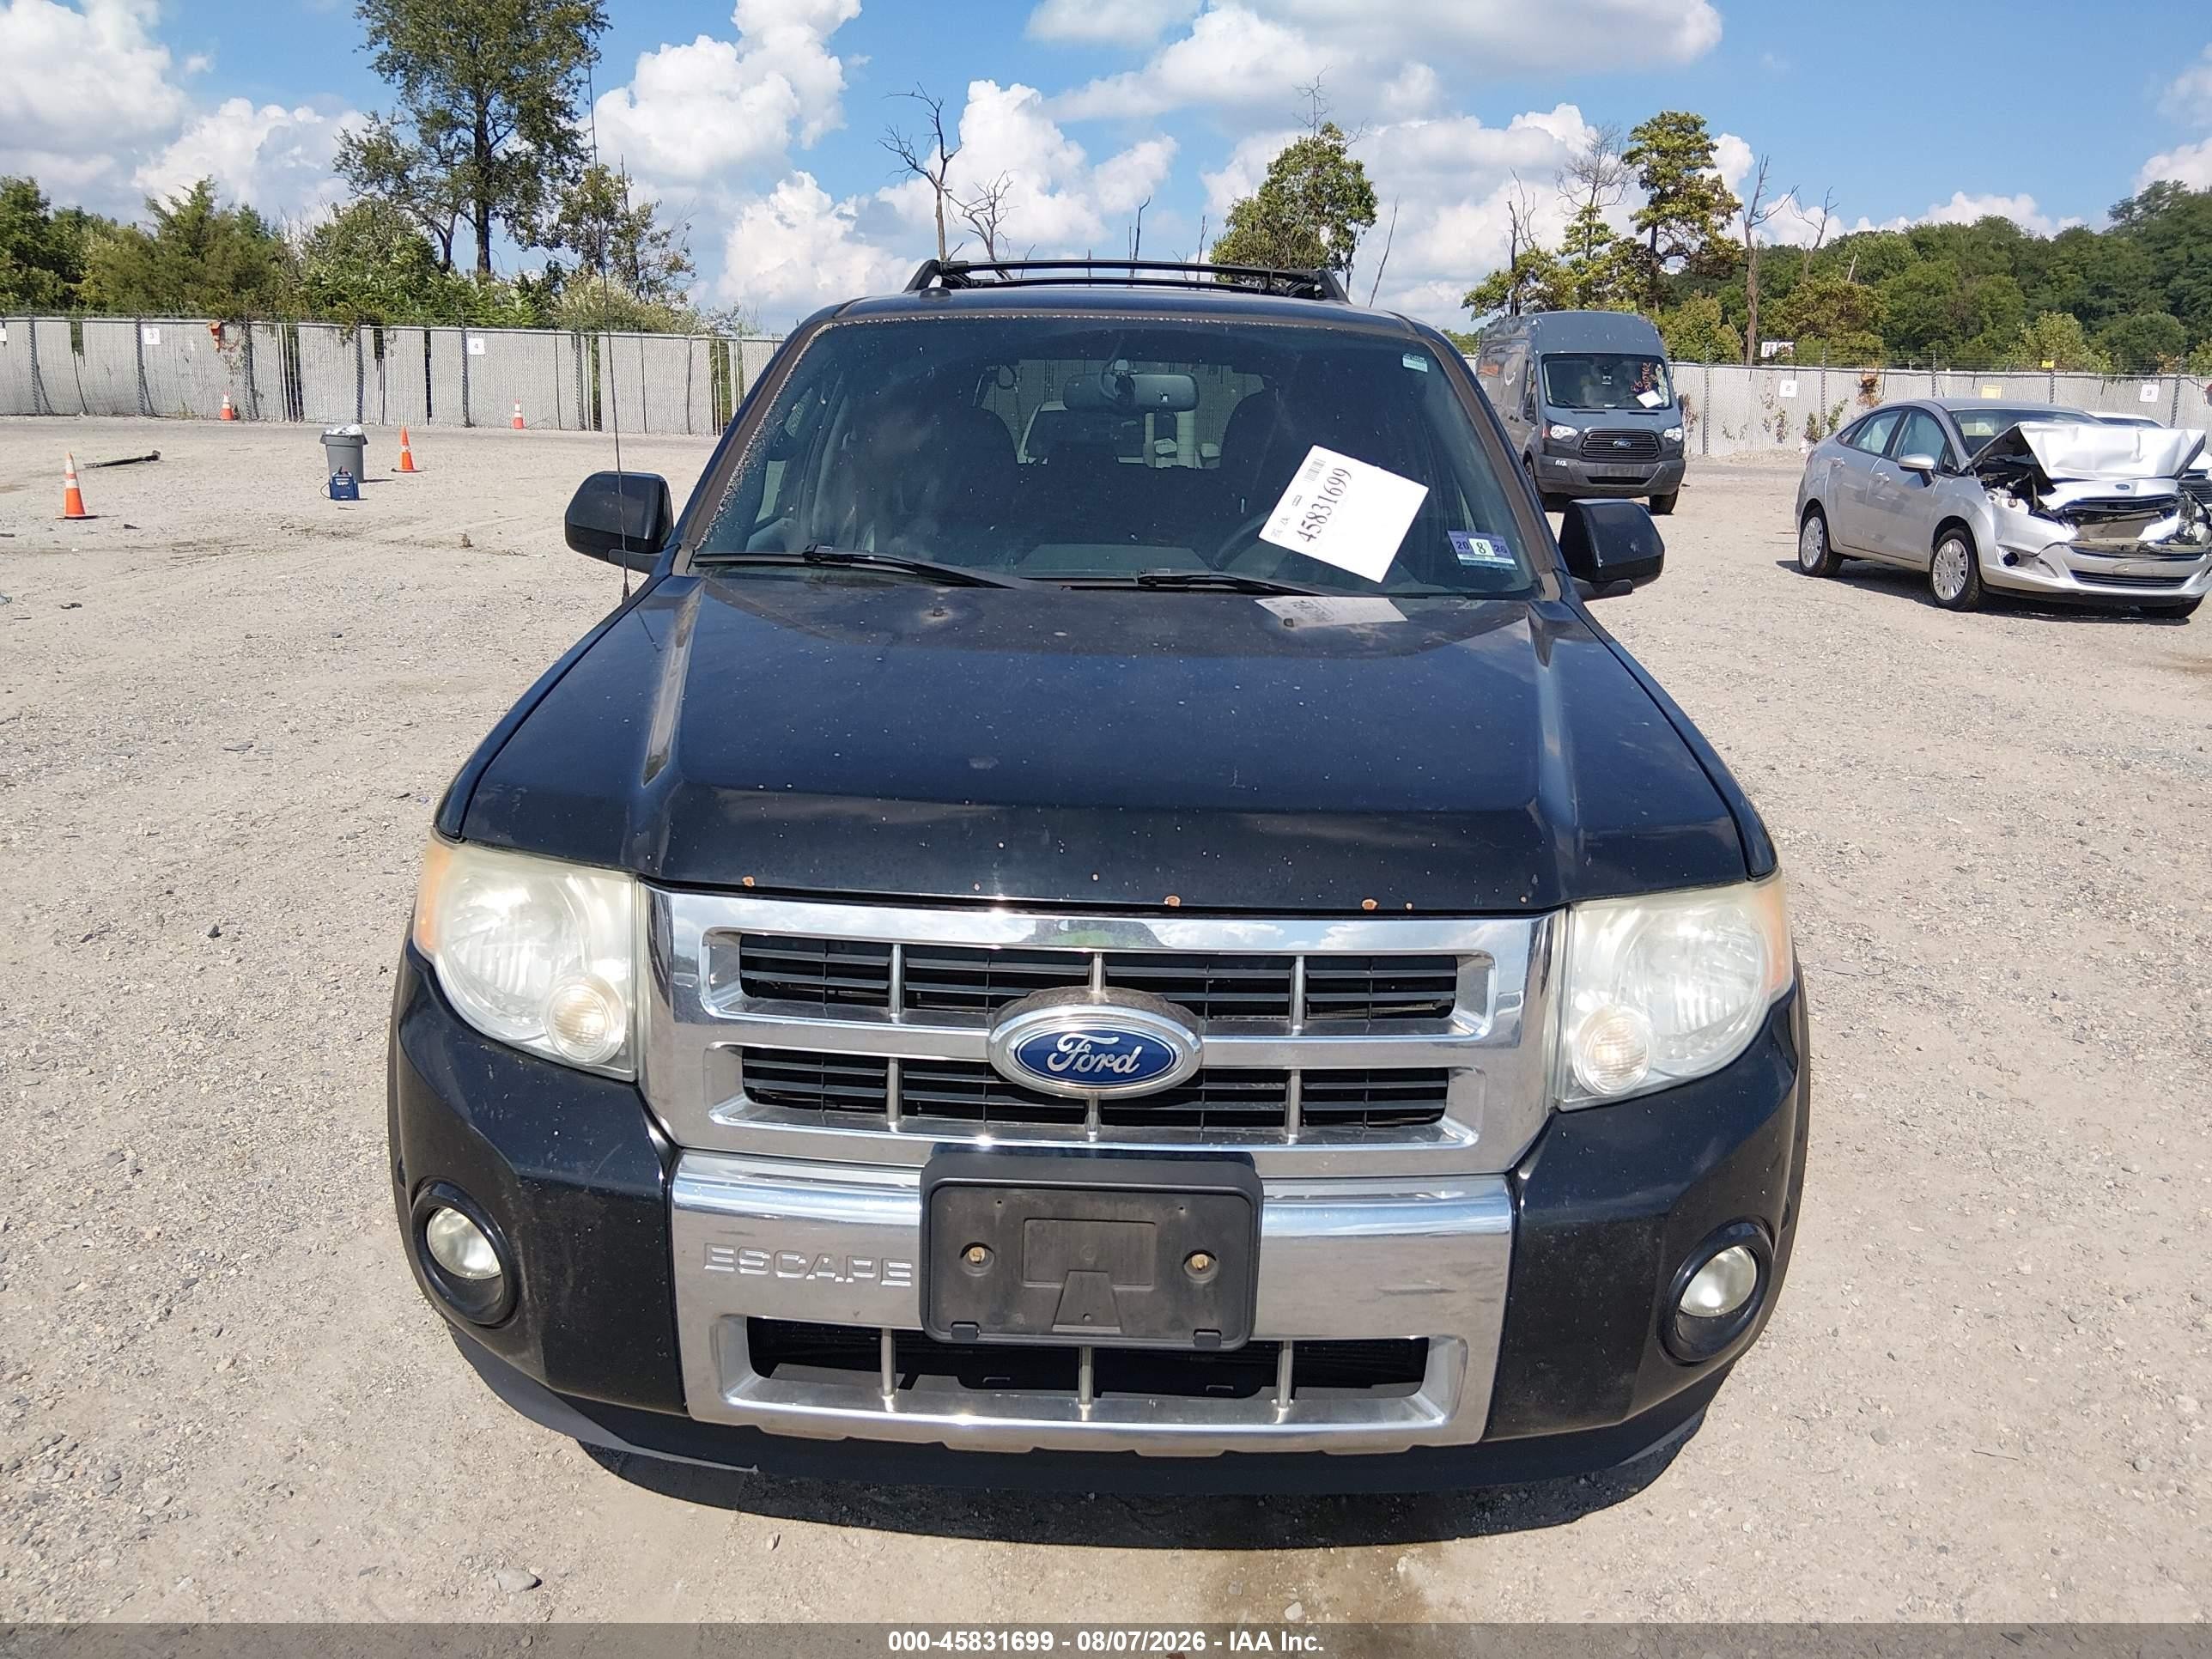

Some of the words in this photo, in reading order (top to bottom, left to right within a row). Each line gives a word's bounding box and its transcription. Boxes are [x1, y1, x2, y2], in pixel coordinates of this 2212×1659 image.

[1297, 468, 1352, 542] 45831699
[1455, 541, 1469, 550] 20
[1476, 542, 1486, 554] 8
[1047, 1033, 1144, 1073] Ford
[704, 1243, 913, 1287] ESCAPE
